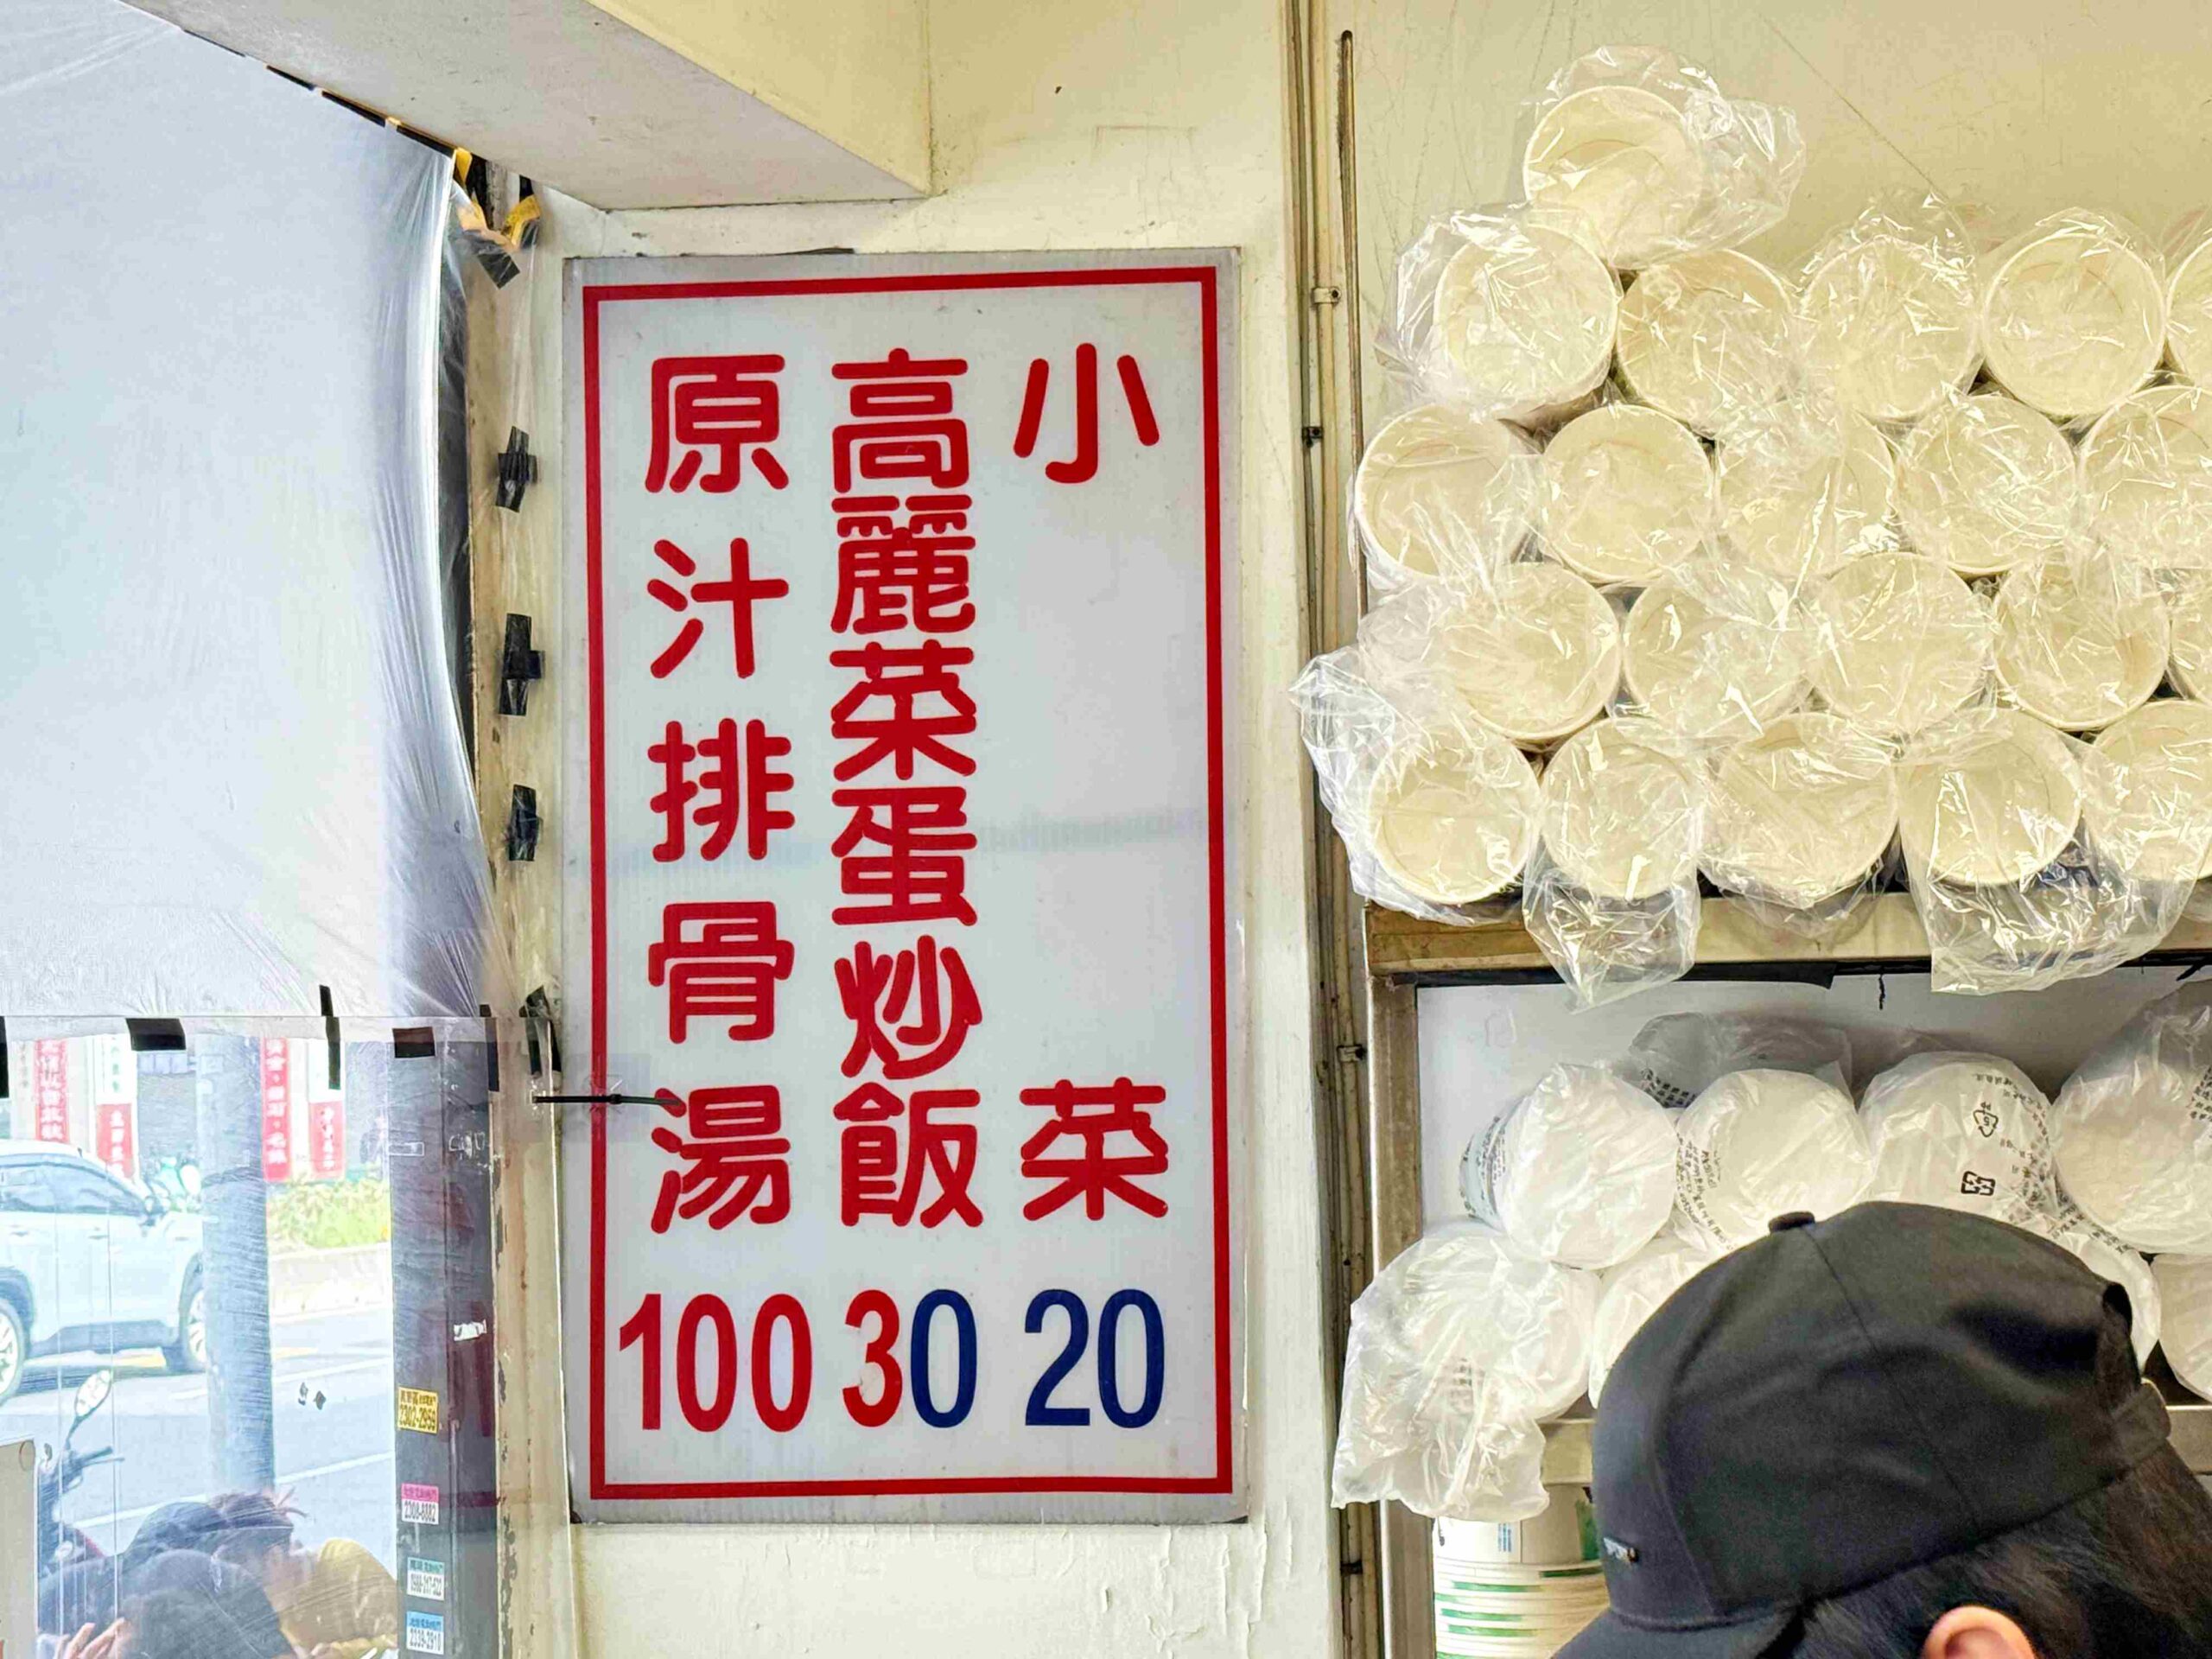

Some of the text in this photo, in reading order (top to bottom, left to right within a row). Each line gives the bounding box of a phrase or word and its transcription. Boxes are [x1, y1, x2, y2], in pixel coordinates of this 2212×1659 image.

[645, 354, 794, 1233] 原汁排骨湯
[830, 348, 983, 1228] 高麗菜蛋炒飯
[1014, 343, 1168, 1220] 小菜
[620, 1294, 812, 1432] 100
[843, 1290, 976, 1427] 30
[1026, 1290, 1164, 1427] 20
